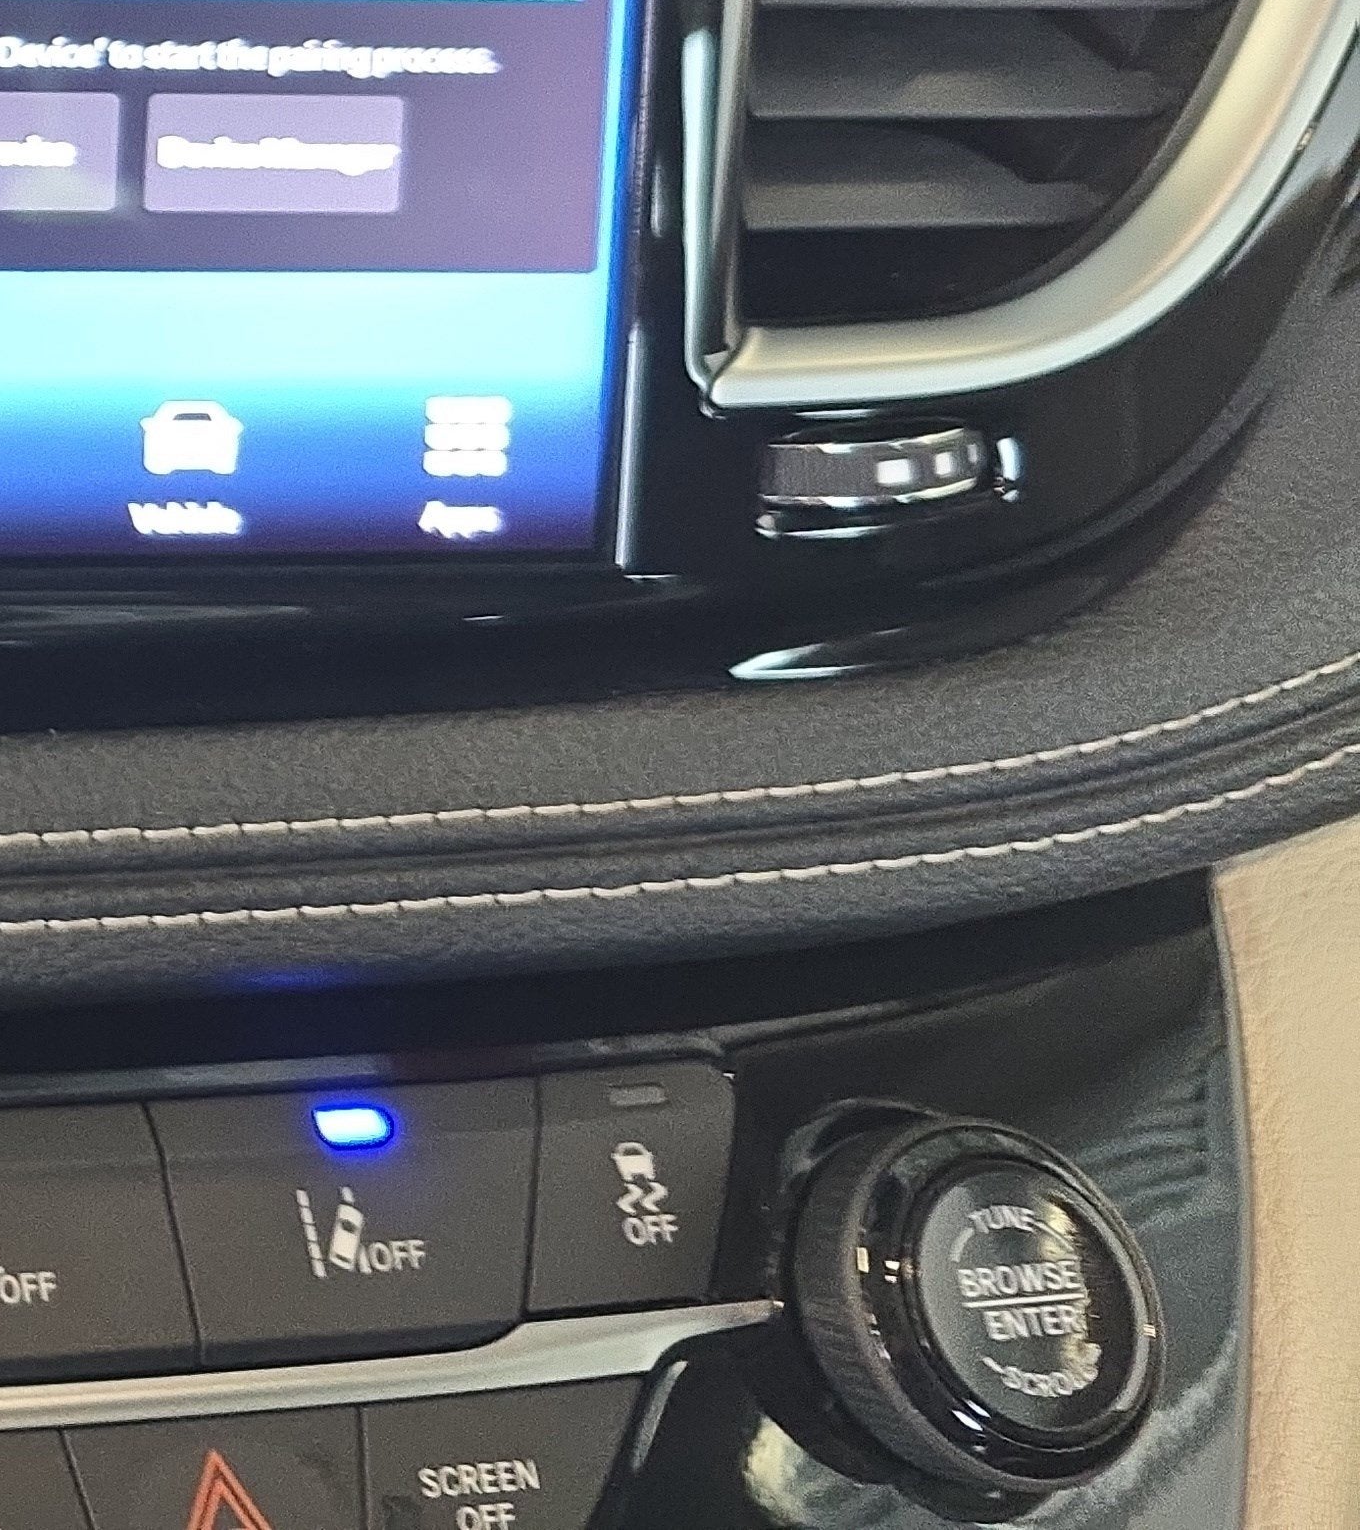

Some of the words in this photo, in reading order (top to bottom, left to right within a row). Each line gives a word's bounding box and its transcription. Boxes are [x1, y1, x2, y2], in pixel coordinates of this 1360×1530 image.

[108, 40, 143, 70] to
[622, 1212, 679, 1248] OFF
[966, 1204, 1036, 1236] TUNE
[371, 1238, 426, 1272] OFF
[957, 1257, 1086, 1299] BROWSE
[982, 1304, 1088, 1343] ENTER
[417, 1458, 542, 1500] SCREEN
[455, 1502, 518, 1530] OFF
